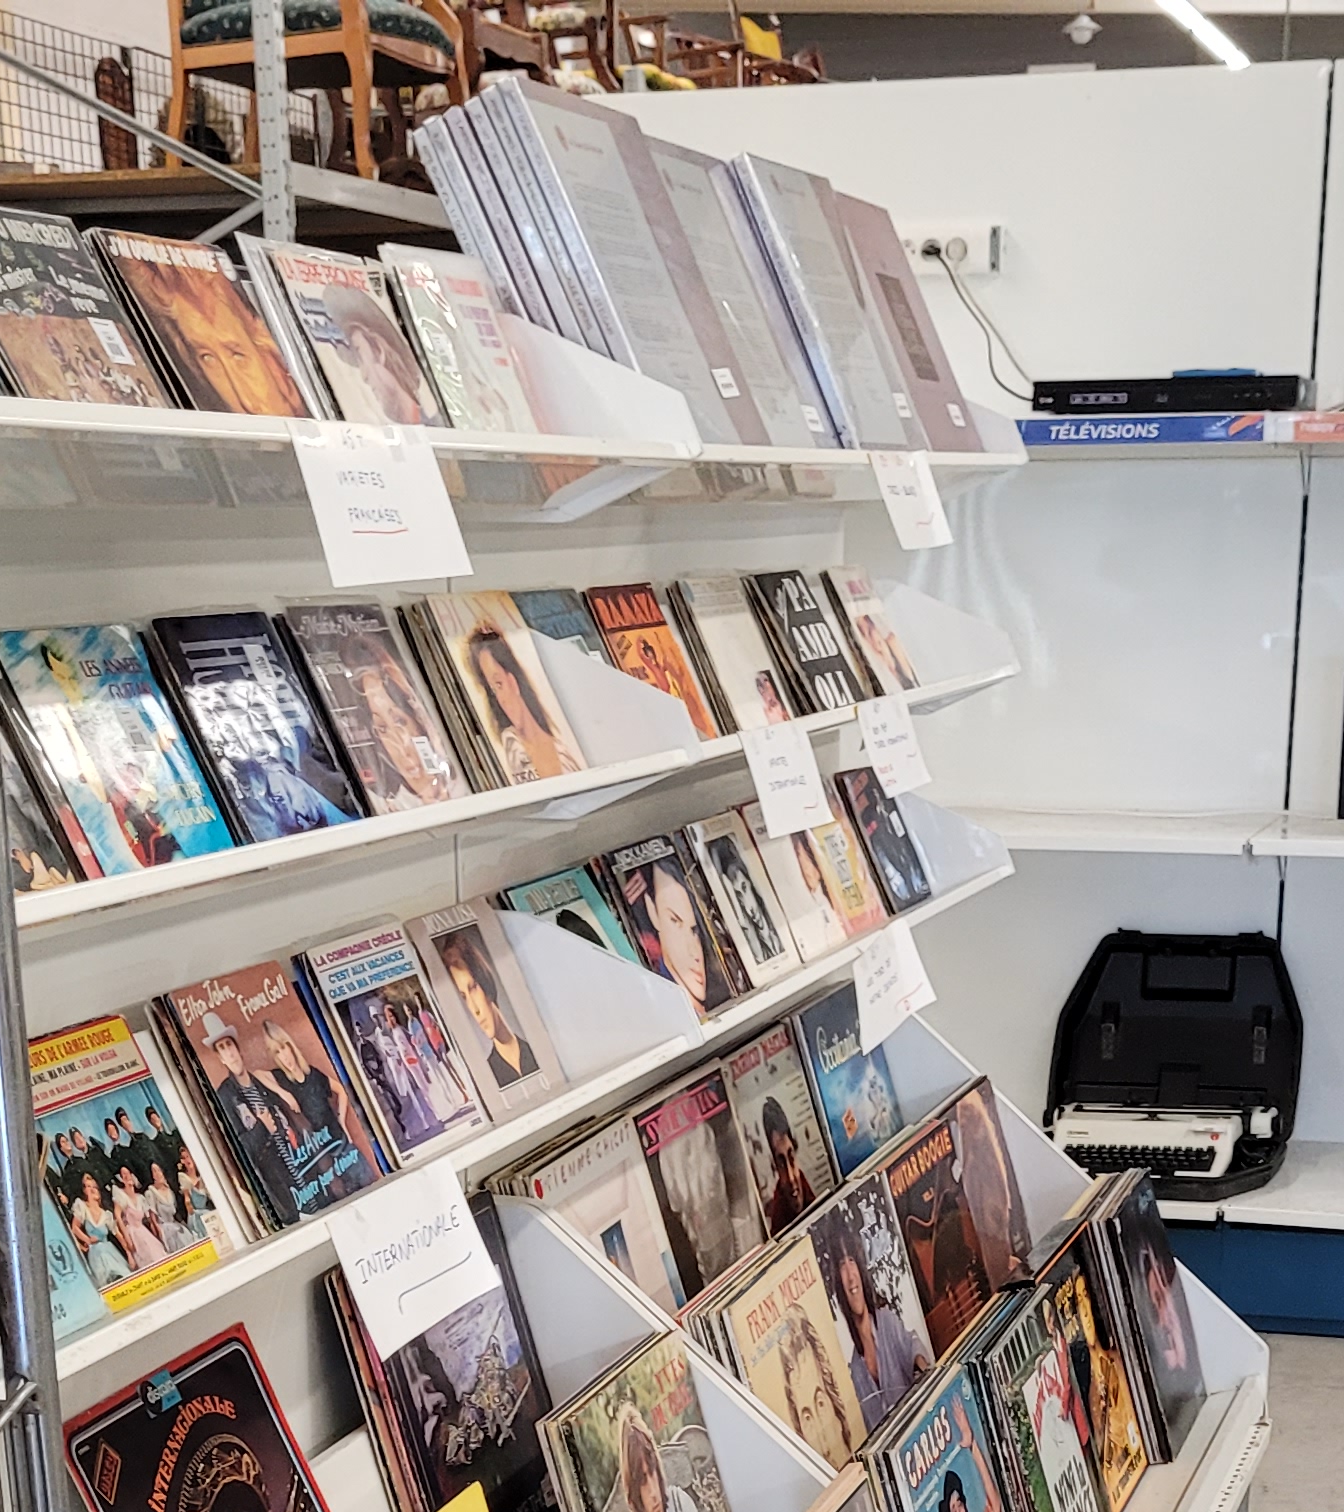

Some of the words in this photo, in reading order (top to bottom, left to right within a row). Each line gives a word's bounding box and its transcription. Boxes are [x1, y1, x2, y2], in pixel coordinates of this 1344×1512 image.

[1049, 421, 1161, 440] TÉLÉVISIONS
[791, 621, 840, 663] AMB
[325, 939, 373, 964] COMPAGNIE
[202, 980, 236, 1015] John
[916, 1127, 954, 1174] BOOGIE
[745, 1293, 781, 1345] FRANK
[777, 1257, 817, 1307] MICHAEL
[902, 1404, 953, 1489] CARLOS
